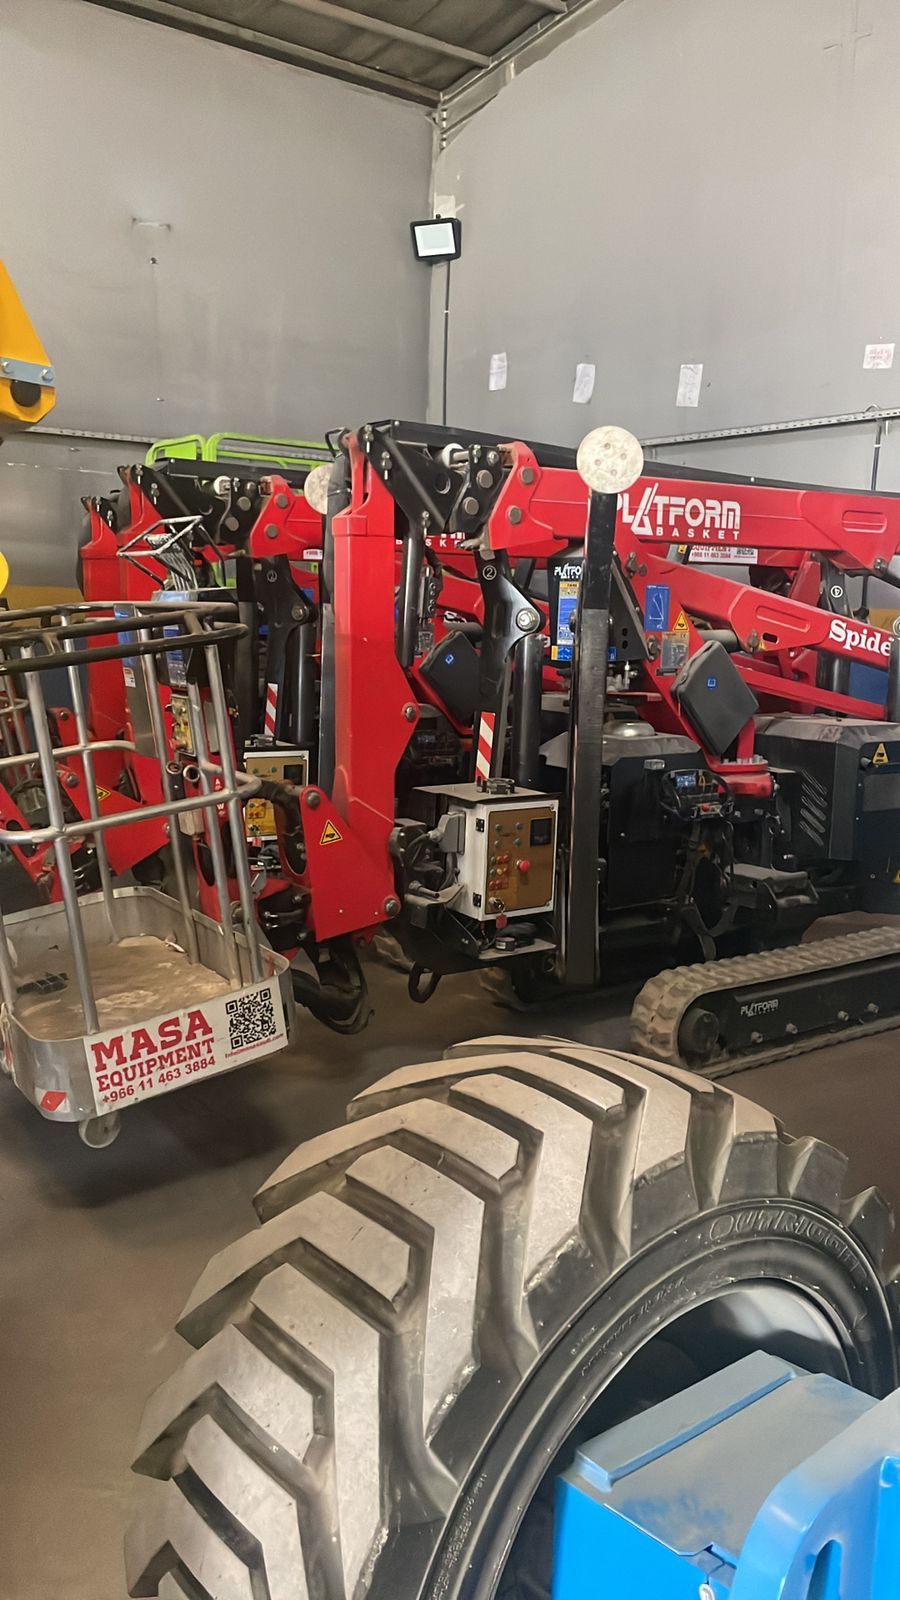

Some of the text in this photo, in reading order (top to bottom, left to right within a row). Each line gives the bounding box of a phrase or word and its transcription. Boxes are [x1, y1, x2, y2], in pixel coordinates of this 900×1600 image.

[656, 528, 741, 540] BASKET
[554, 562, 582, 579] PLATFO
[829, 619, 893, 657] Spide
[740, 998, 779, 1017] PLATFORM
[91, 1009, 213, 1072] MASA
[96, 1037, 215, 1092] EQUIPMENT
[102, 1055, 216, 1104] +966 11 463 3884
